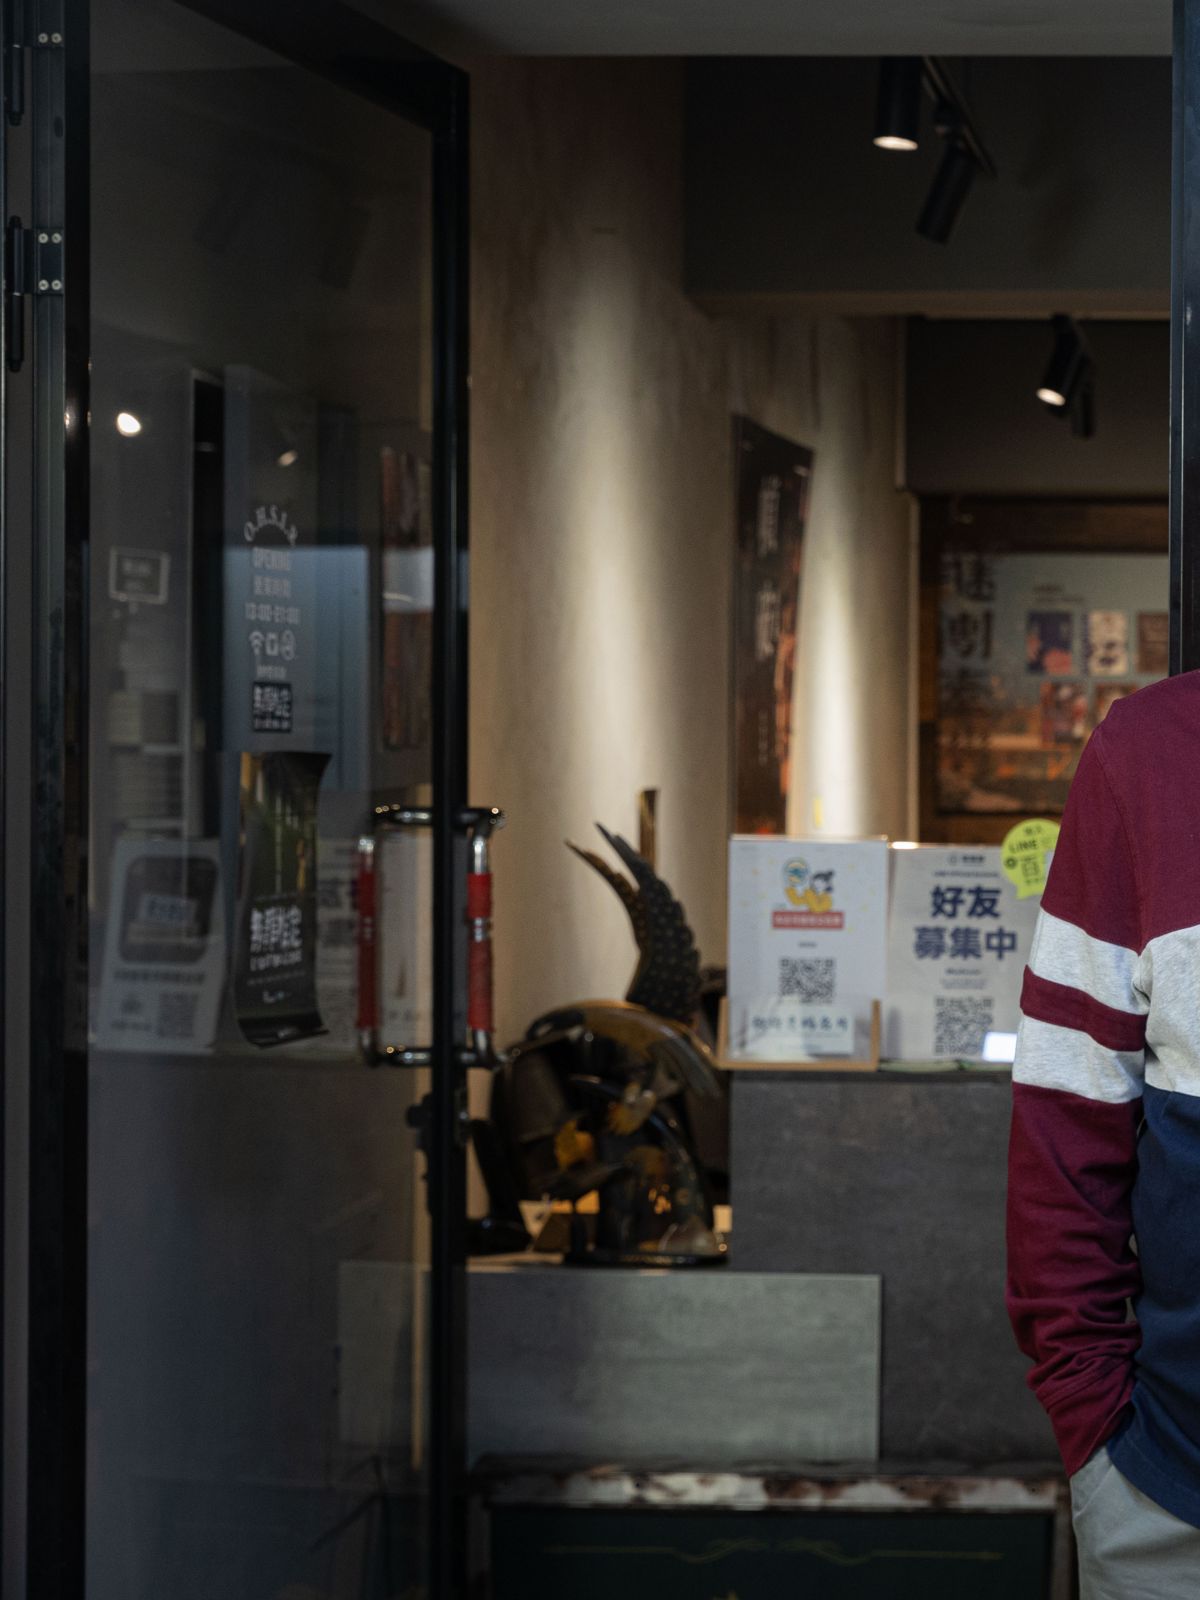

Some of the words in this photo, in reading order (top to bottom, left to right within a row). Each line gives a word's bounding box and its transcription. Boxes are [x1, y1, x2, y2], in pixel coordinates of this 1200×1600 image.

[930, 885, 1001, 919] 好友
[914, 926, 1017, 960] 募集中
